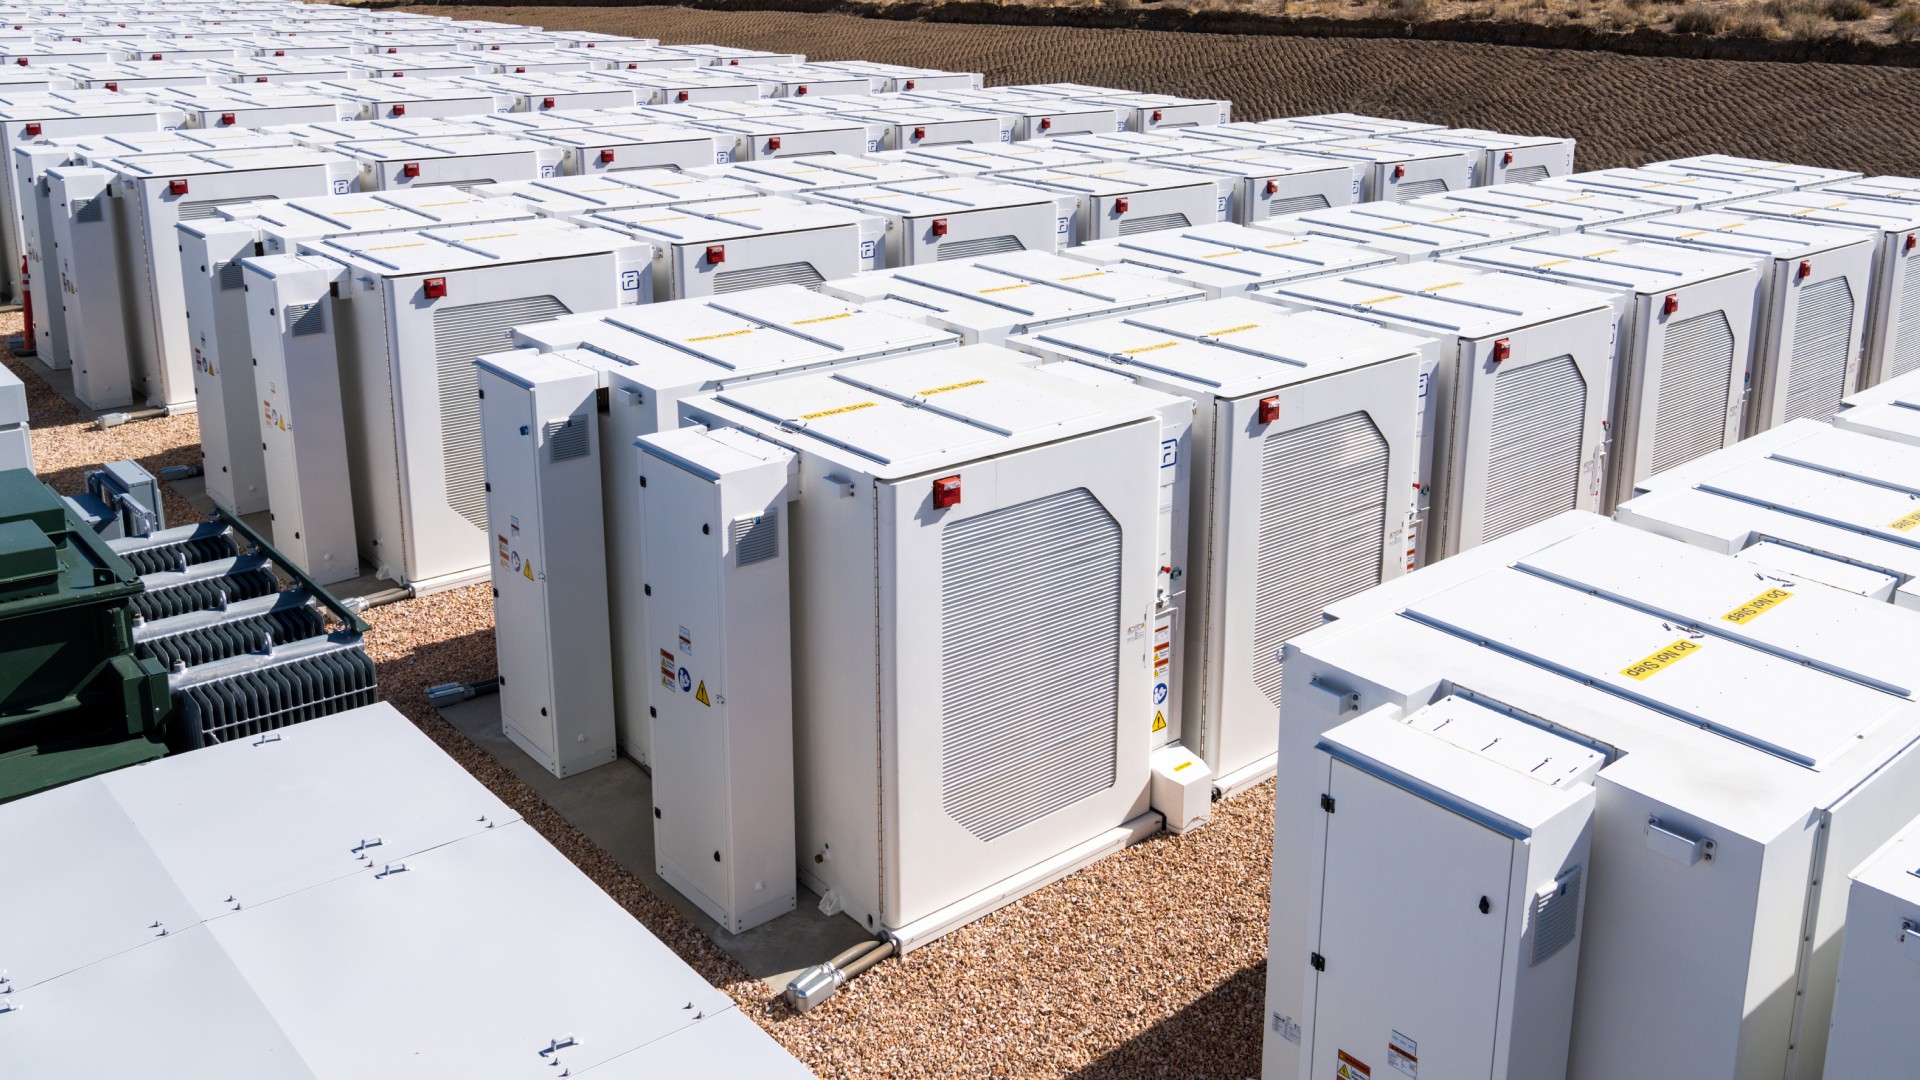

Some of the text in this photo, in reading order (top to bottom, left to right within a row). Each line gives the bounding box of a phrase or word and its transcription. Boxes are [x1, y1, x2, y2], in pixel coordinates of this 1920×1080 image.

[1727, 589, 1788, 621] Do Not Step
[1626, 641, 1697, 677] Do Not Step
